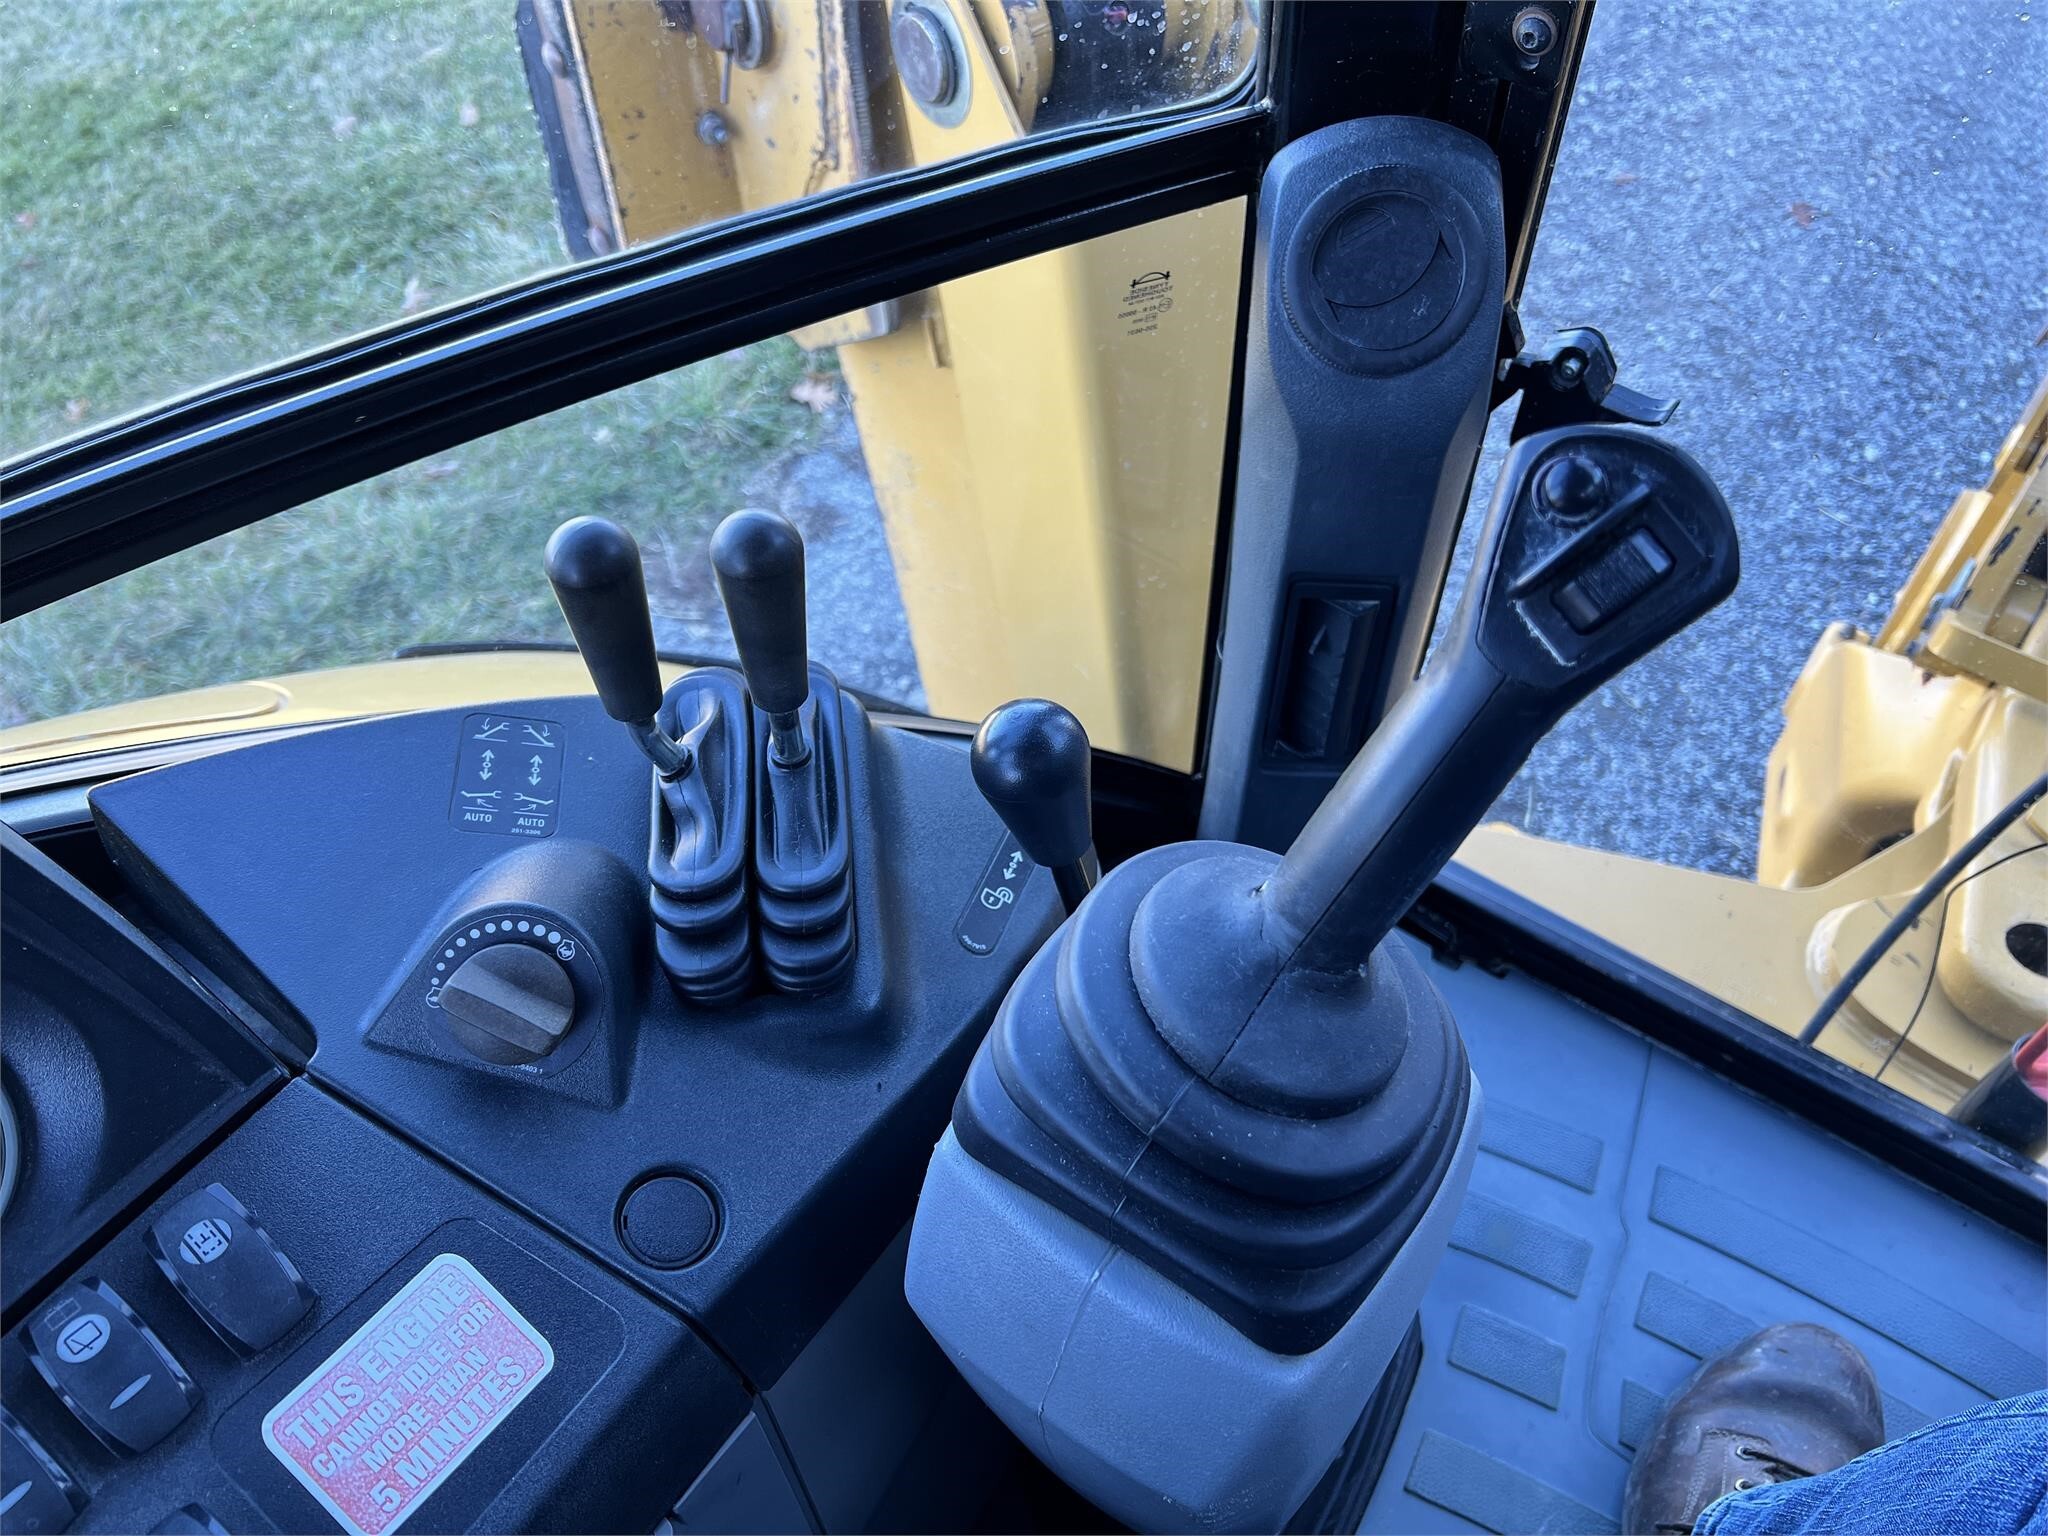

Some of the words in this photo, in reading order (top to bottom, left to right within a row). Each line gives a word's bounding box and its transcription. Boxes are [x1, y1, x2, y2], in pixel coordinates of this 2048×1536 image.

[464, 812, 492, 823] AUTO
[517, 817, 545, 828] AUTO
[284, 1374, 367, 1452] THIS
[356, 1272, 471, 1385] ENGINE
[311, 1386, 403, 1479] CANNOT
[398, 1342, 450, 1393] IDLE
[445, 1300, 496, 1349] FOR
[363, 1401, 436, 1474] MORE
[427, 1345, 490, 1405] THAN
[367, 1478, 402, 1514] 5
[393, 1355, 527, 1490] MINUTES
